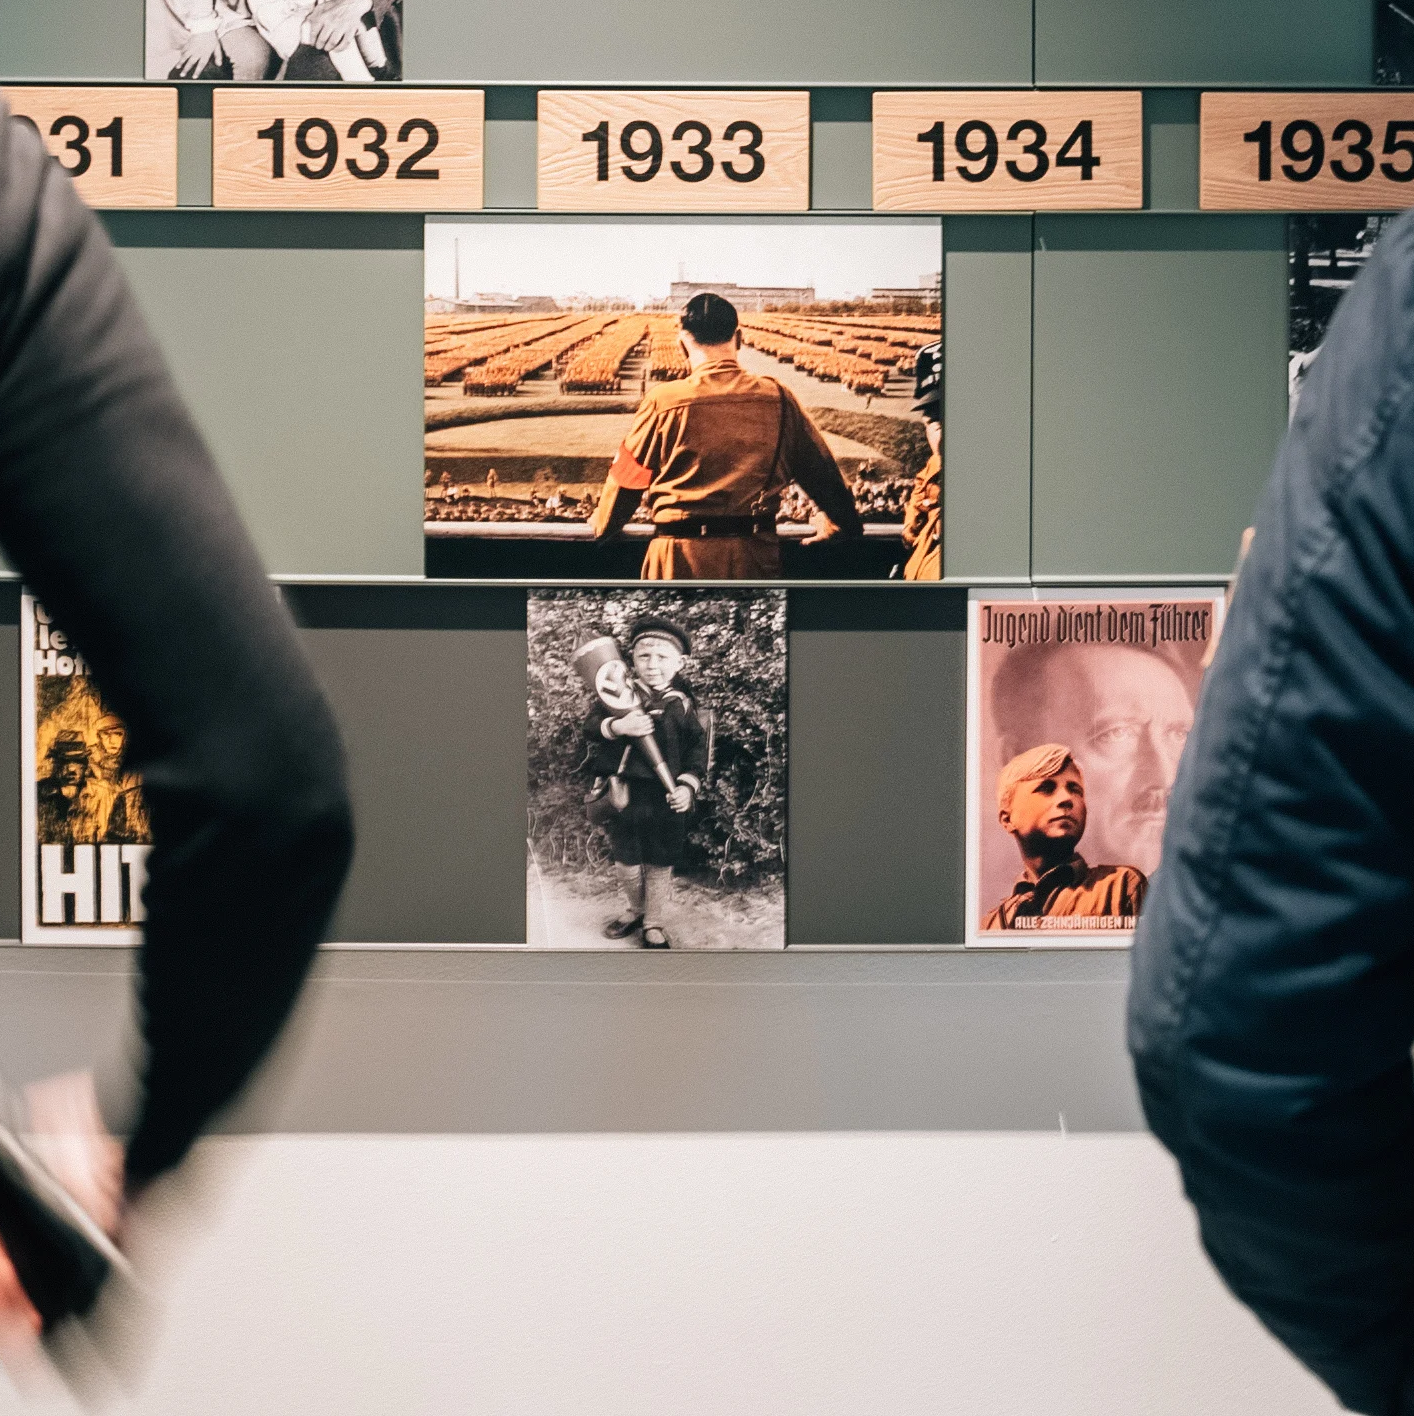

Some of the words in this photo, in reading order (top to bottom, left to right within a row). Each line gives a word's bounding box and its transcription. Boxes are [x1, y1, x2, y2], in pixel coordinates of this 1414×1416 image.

[11, 114, 123, 177] 31
[256, 117, 441, 181] 1932
[581, 120, 766, 183] 1933
[916, 119, 1101, 183] 1934
[39, 625, 68, 650] le
[982, 604, 1050, 648] Jugend
[1056, 604, 1102, 643] dient
[1107, 604, 1146, 643] dem
[1148, 603, 1209, 648] Führer
[35, 650, 92, 676] Hof
[41, 844, 155, 924] HIT
[1015, 915, 1037, 929] ALLE
